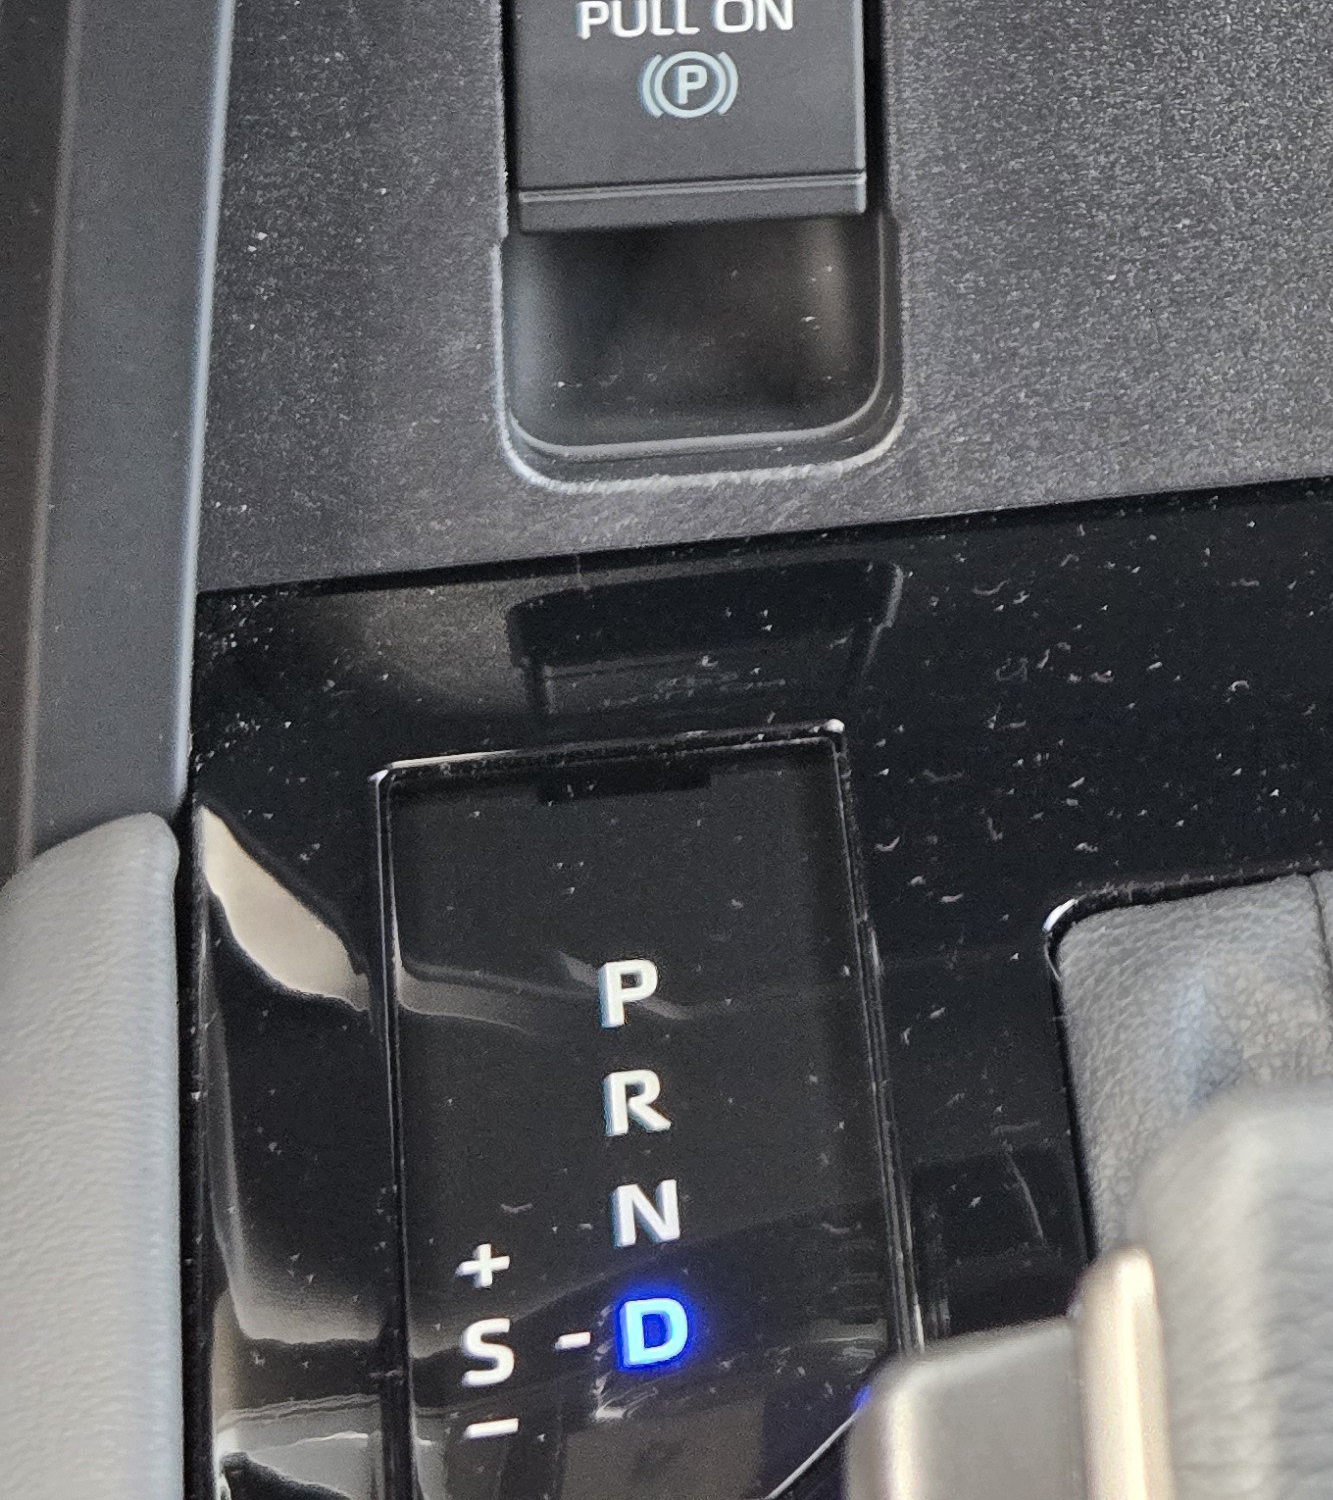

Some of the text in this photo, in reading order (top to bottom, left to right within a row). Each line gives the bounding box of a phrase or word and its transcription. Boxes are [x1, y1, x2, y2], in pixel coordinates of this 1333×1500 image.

[675, 64, 708, 104] P
[600, 958, 659, 1028] P
[603, 1069, 672, 1136] R
[611, 1179, 680, 1248] N
[462, 1317, 515, 1388] S
[618, 1296, 689, 1370] D
